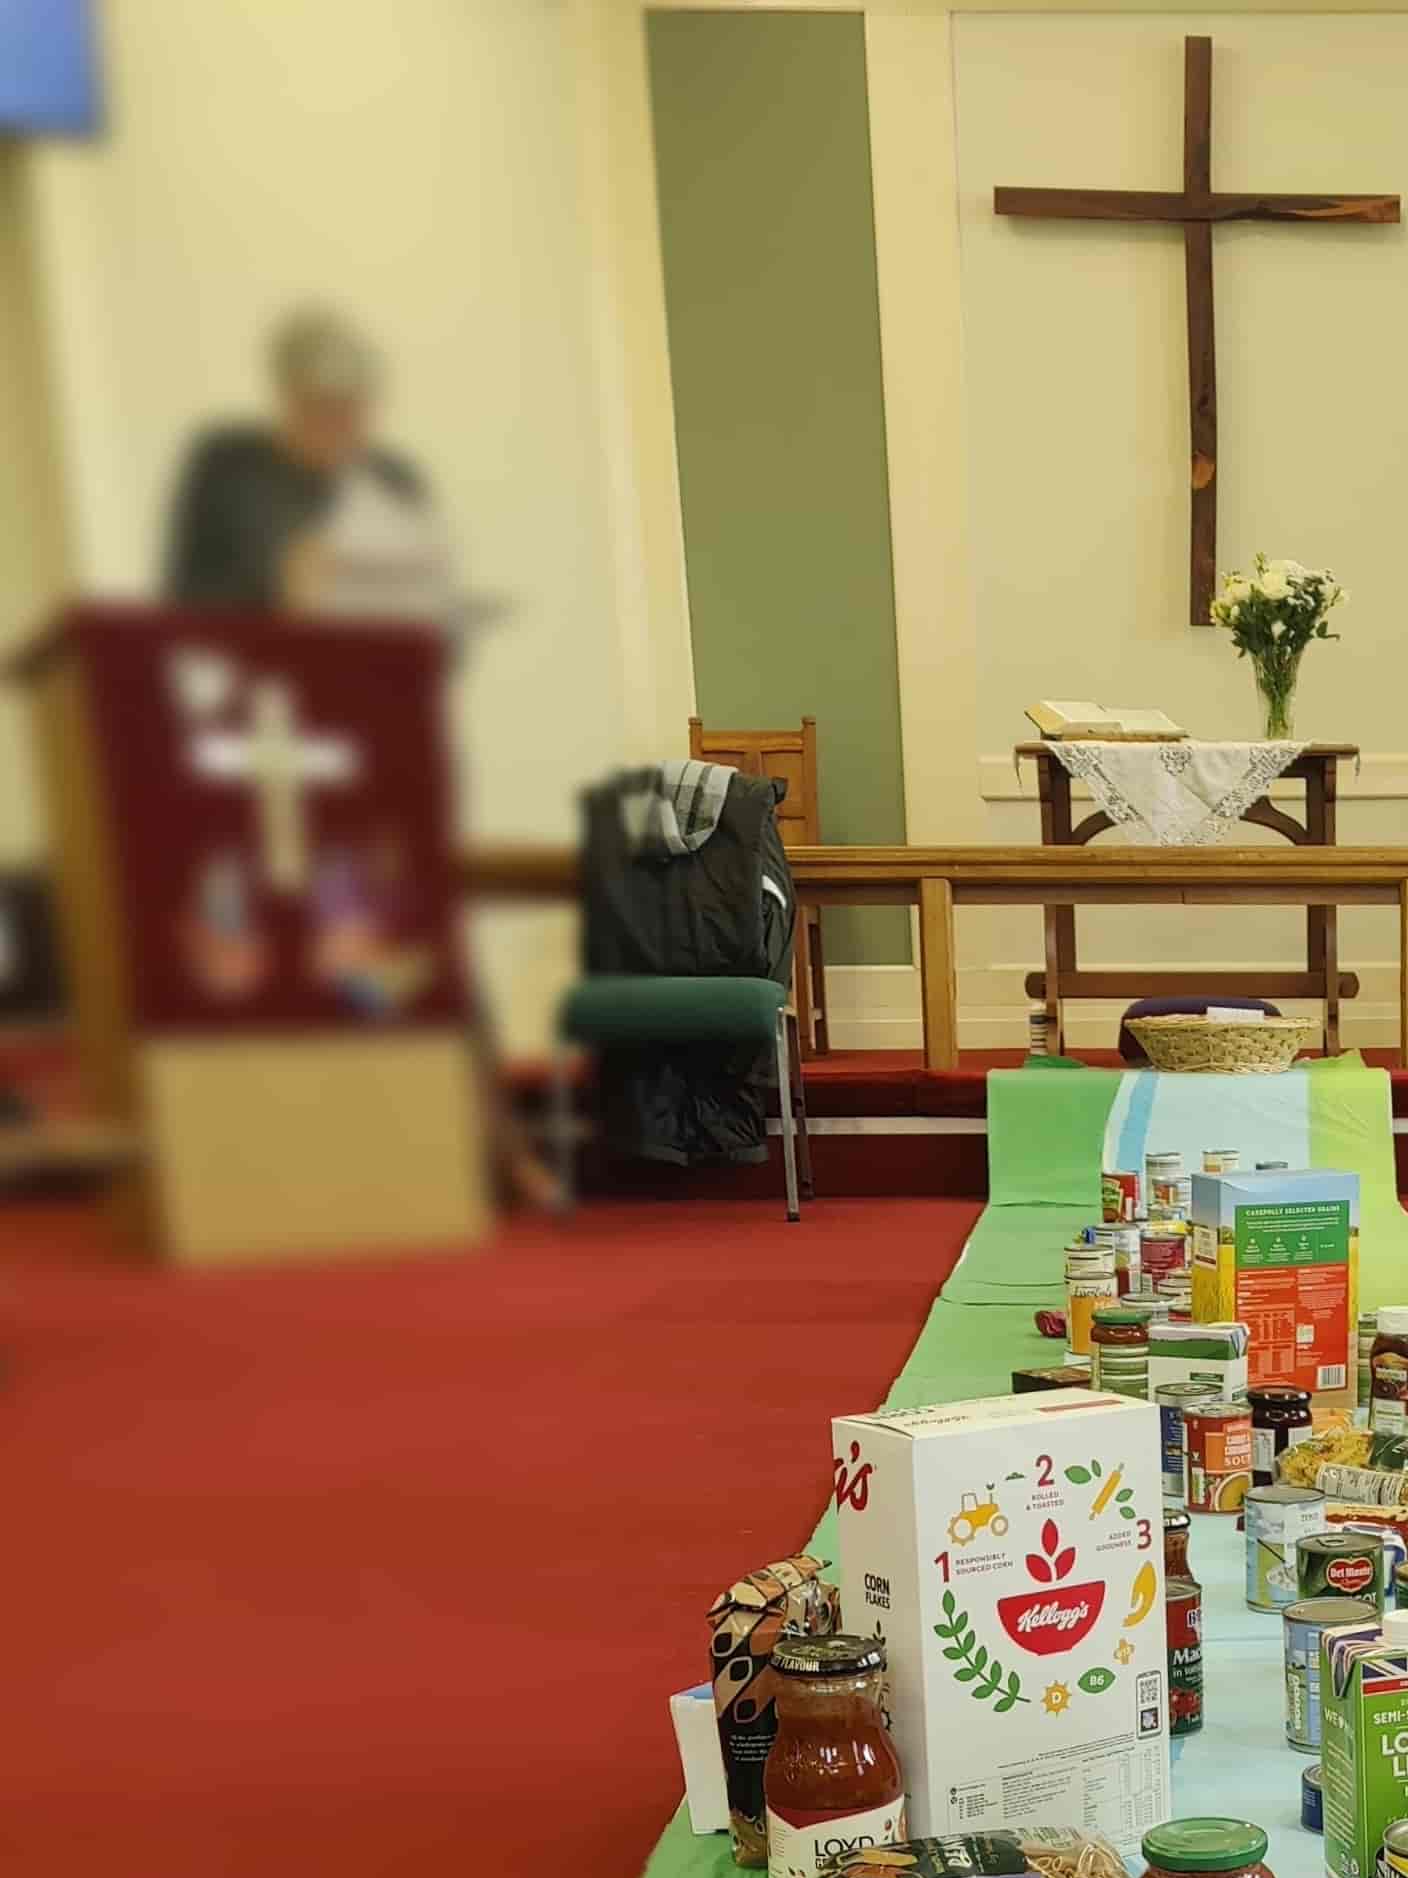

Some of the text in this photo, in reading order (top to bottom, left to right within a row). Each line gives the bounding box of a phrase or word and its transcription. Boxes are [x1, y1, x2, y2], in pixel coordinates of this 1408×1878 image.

[1035, 1455, 1055, 1487] 2
[1031, 1490, 1060, 1502] ROLLED
[1033, 1498, 1064, 1510] TOASTED
[1135, 1519, 1153, 1550] 3
[934, 1551, 950, 1583] 1
[955, 1552, 1007, 1566] RESPONSIBLY
[955, 1560, 1014, 1575] SOURCED CORN
[1330, 1566, 1344, 1578] Del
[864, 1572, 890, 1596] CORN
[865, 1591, 890, 1610] FLAKES
[1016, 1600, 1090, 1632] Kellogg's
[1089, 1674, 1105, 1687] B6
